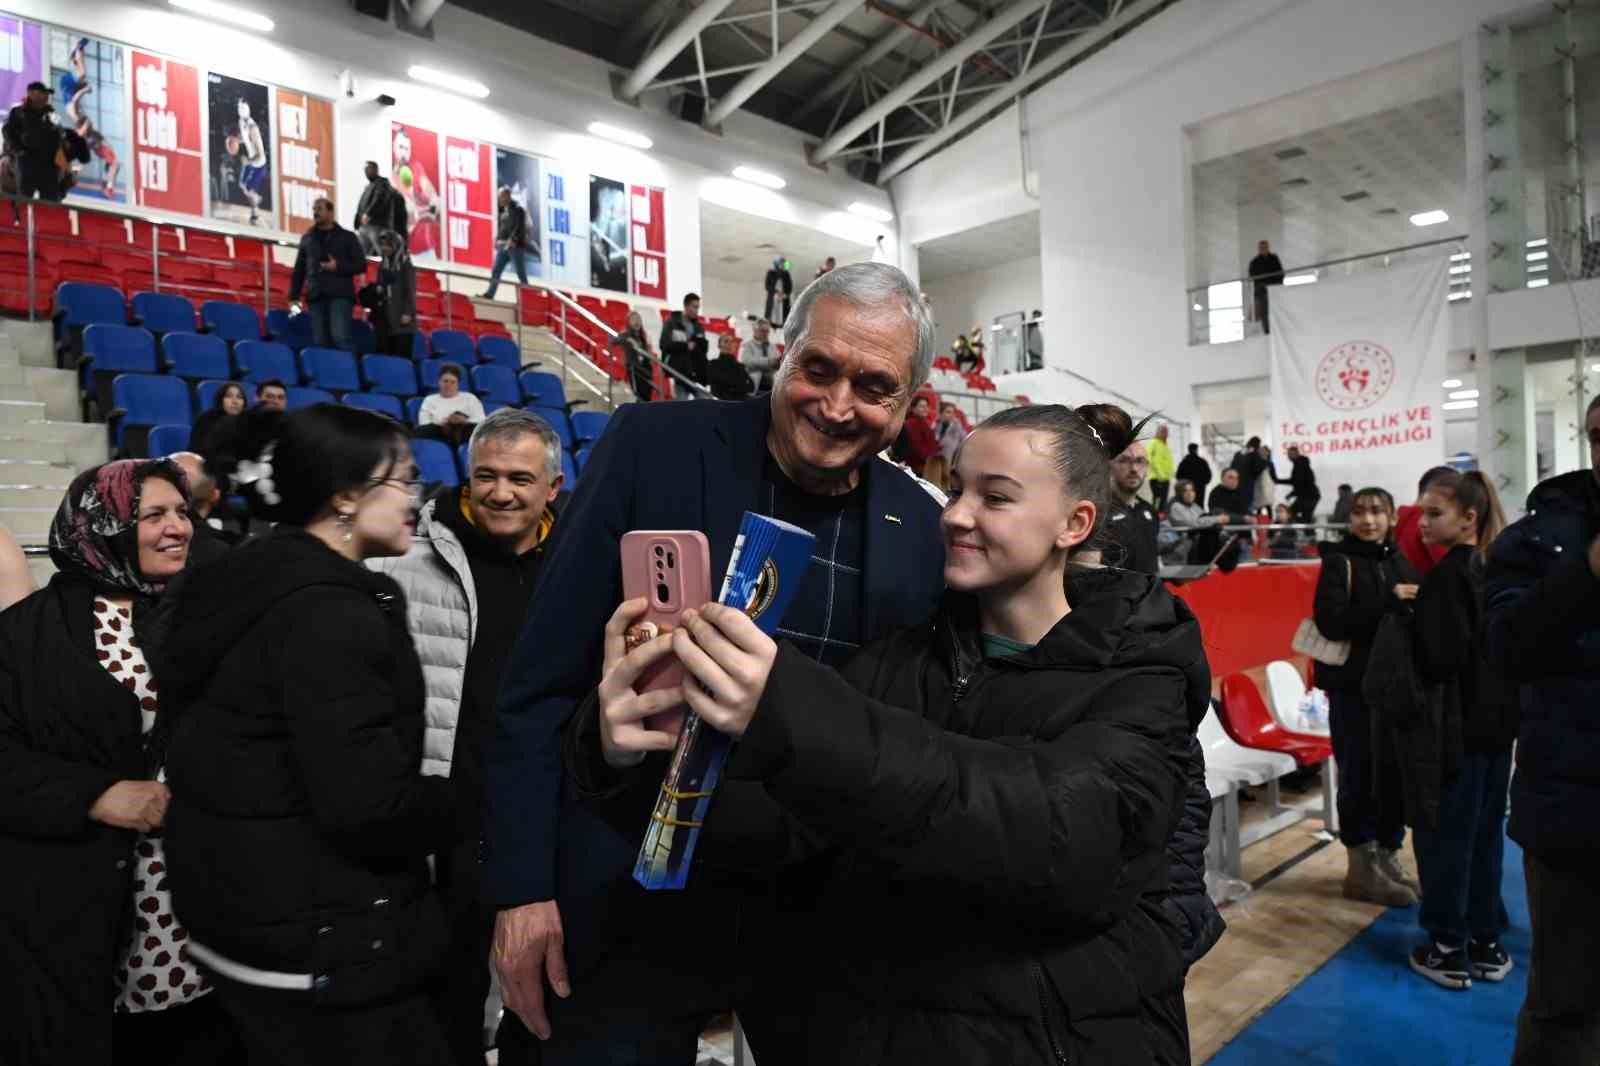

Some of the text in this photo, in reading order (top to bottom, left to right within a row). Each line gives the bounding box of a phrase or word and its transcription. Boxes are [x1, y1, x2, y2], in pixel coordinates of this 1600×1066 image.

[1281, 421, 1311, 436] T.C.
[1406, 405, 1432, 422] VE
[1329, 425, 1432, 451] BAKANLIĞI
